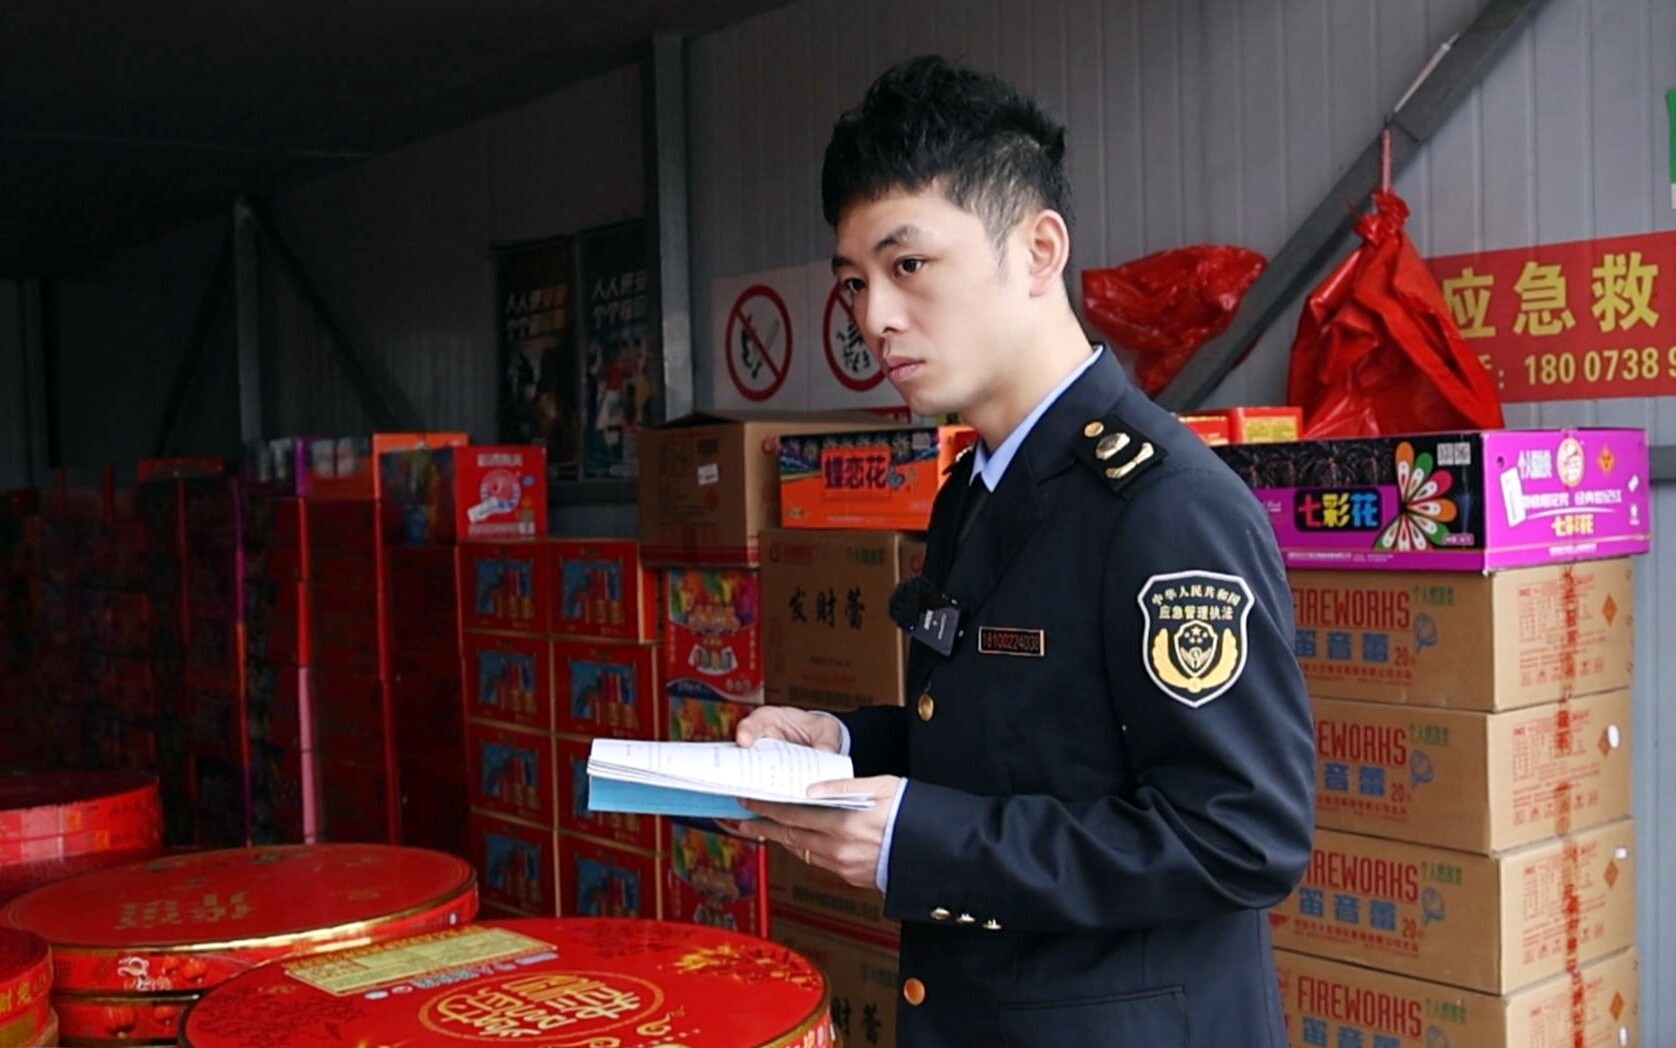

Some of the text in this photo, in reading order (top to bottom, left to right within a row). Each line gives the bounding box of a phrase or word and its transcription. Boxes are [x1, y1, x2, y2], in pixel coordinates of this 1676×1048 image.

[1524, 353, 1576, 385] 180
[1584, 347, 1659, 382] 0738
[1298, 493, 1378, 528] 七彩花
[1152, 584, 1241, 607] 中华人民共和国
[1159, 605, 1234, 620] 应急管理执法
[1298, 975, 1422, 1039] FIREWORKS
